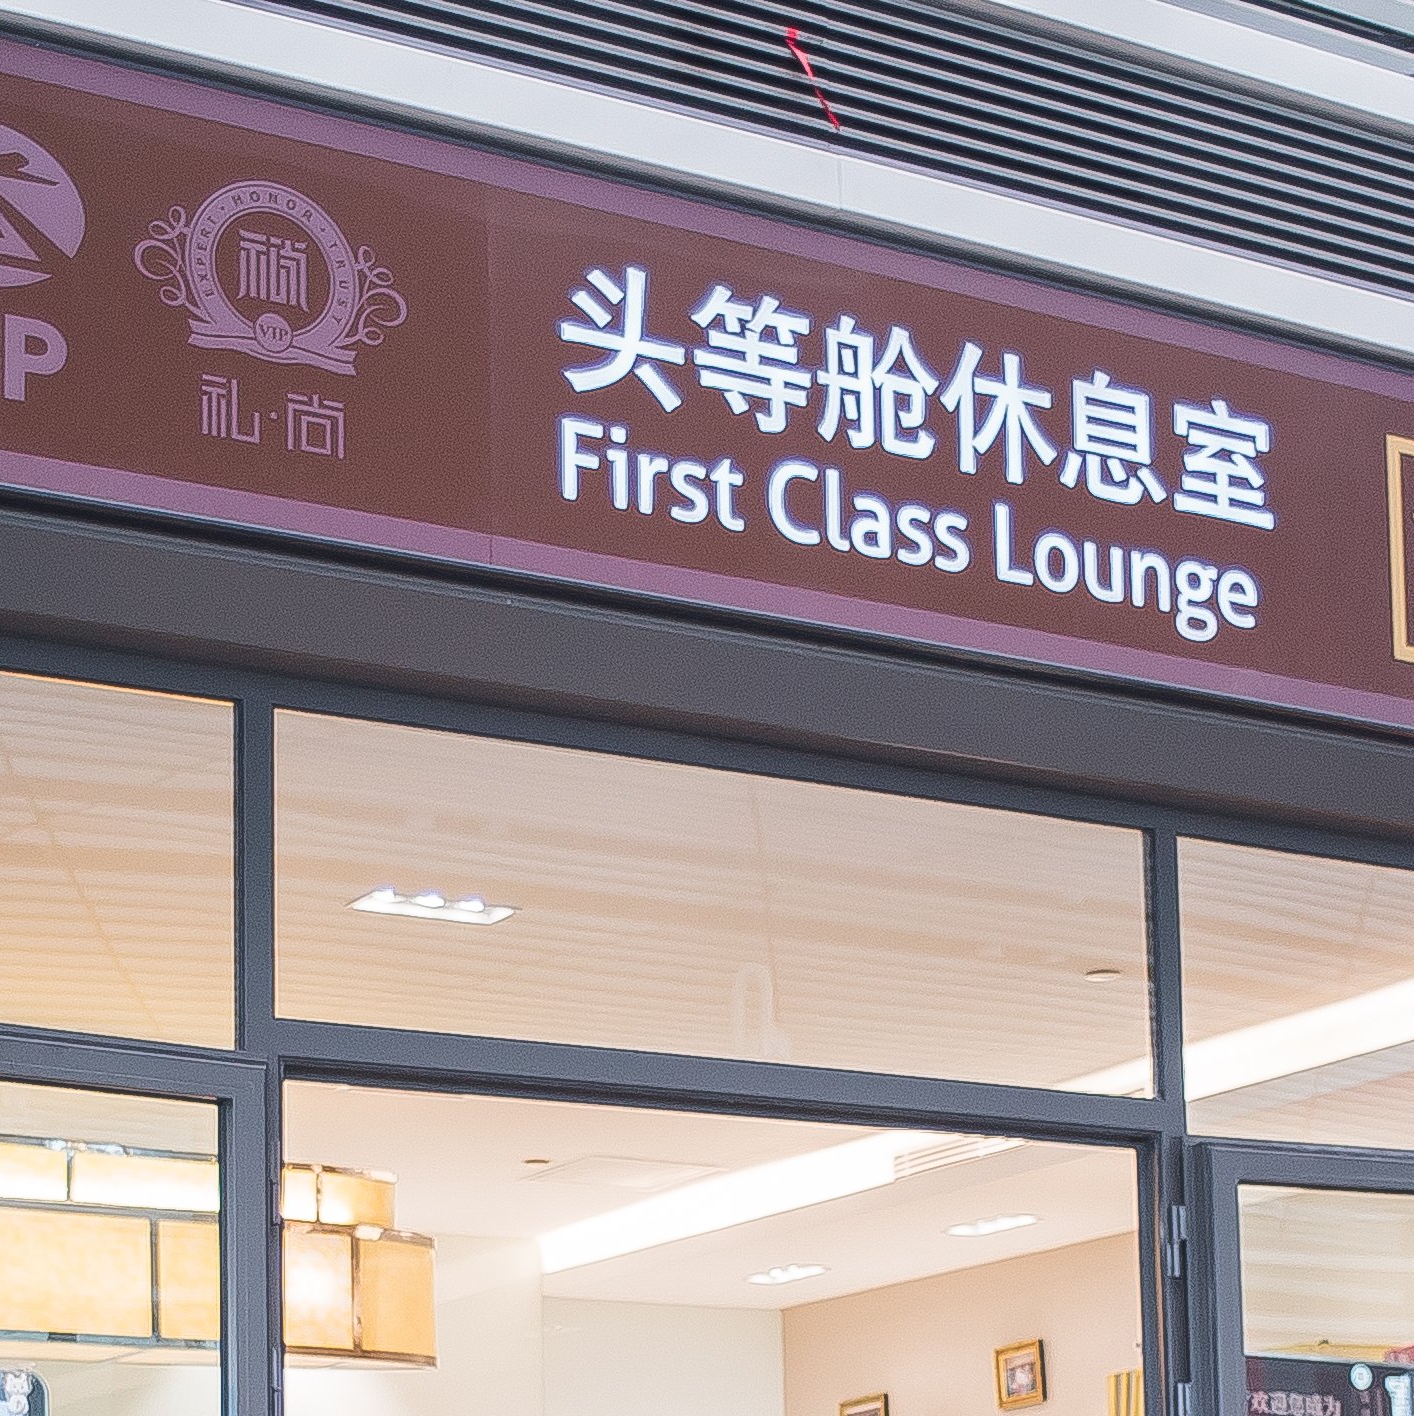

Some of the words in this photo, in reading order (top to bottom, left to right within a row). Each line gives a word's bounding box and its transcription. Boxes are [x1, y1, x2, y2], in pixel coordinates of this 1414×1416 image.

[258, 320, 289, 343] VIP
[557, 264, 1276, 531] 头等舱休息室
[559, 416, 746, 534] First
[767, 460, 972, 575] Class
[993, 501, 1261, 644] Lounge
